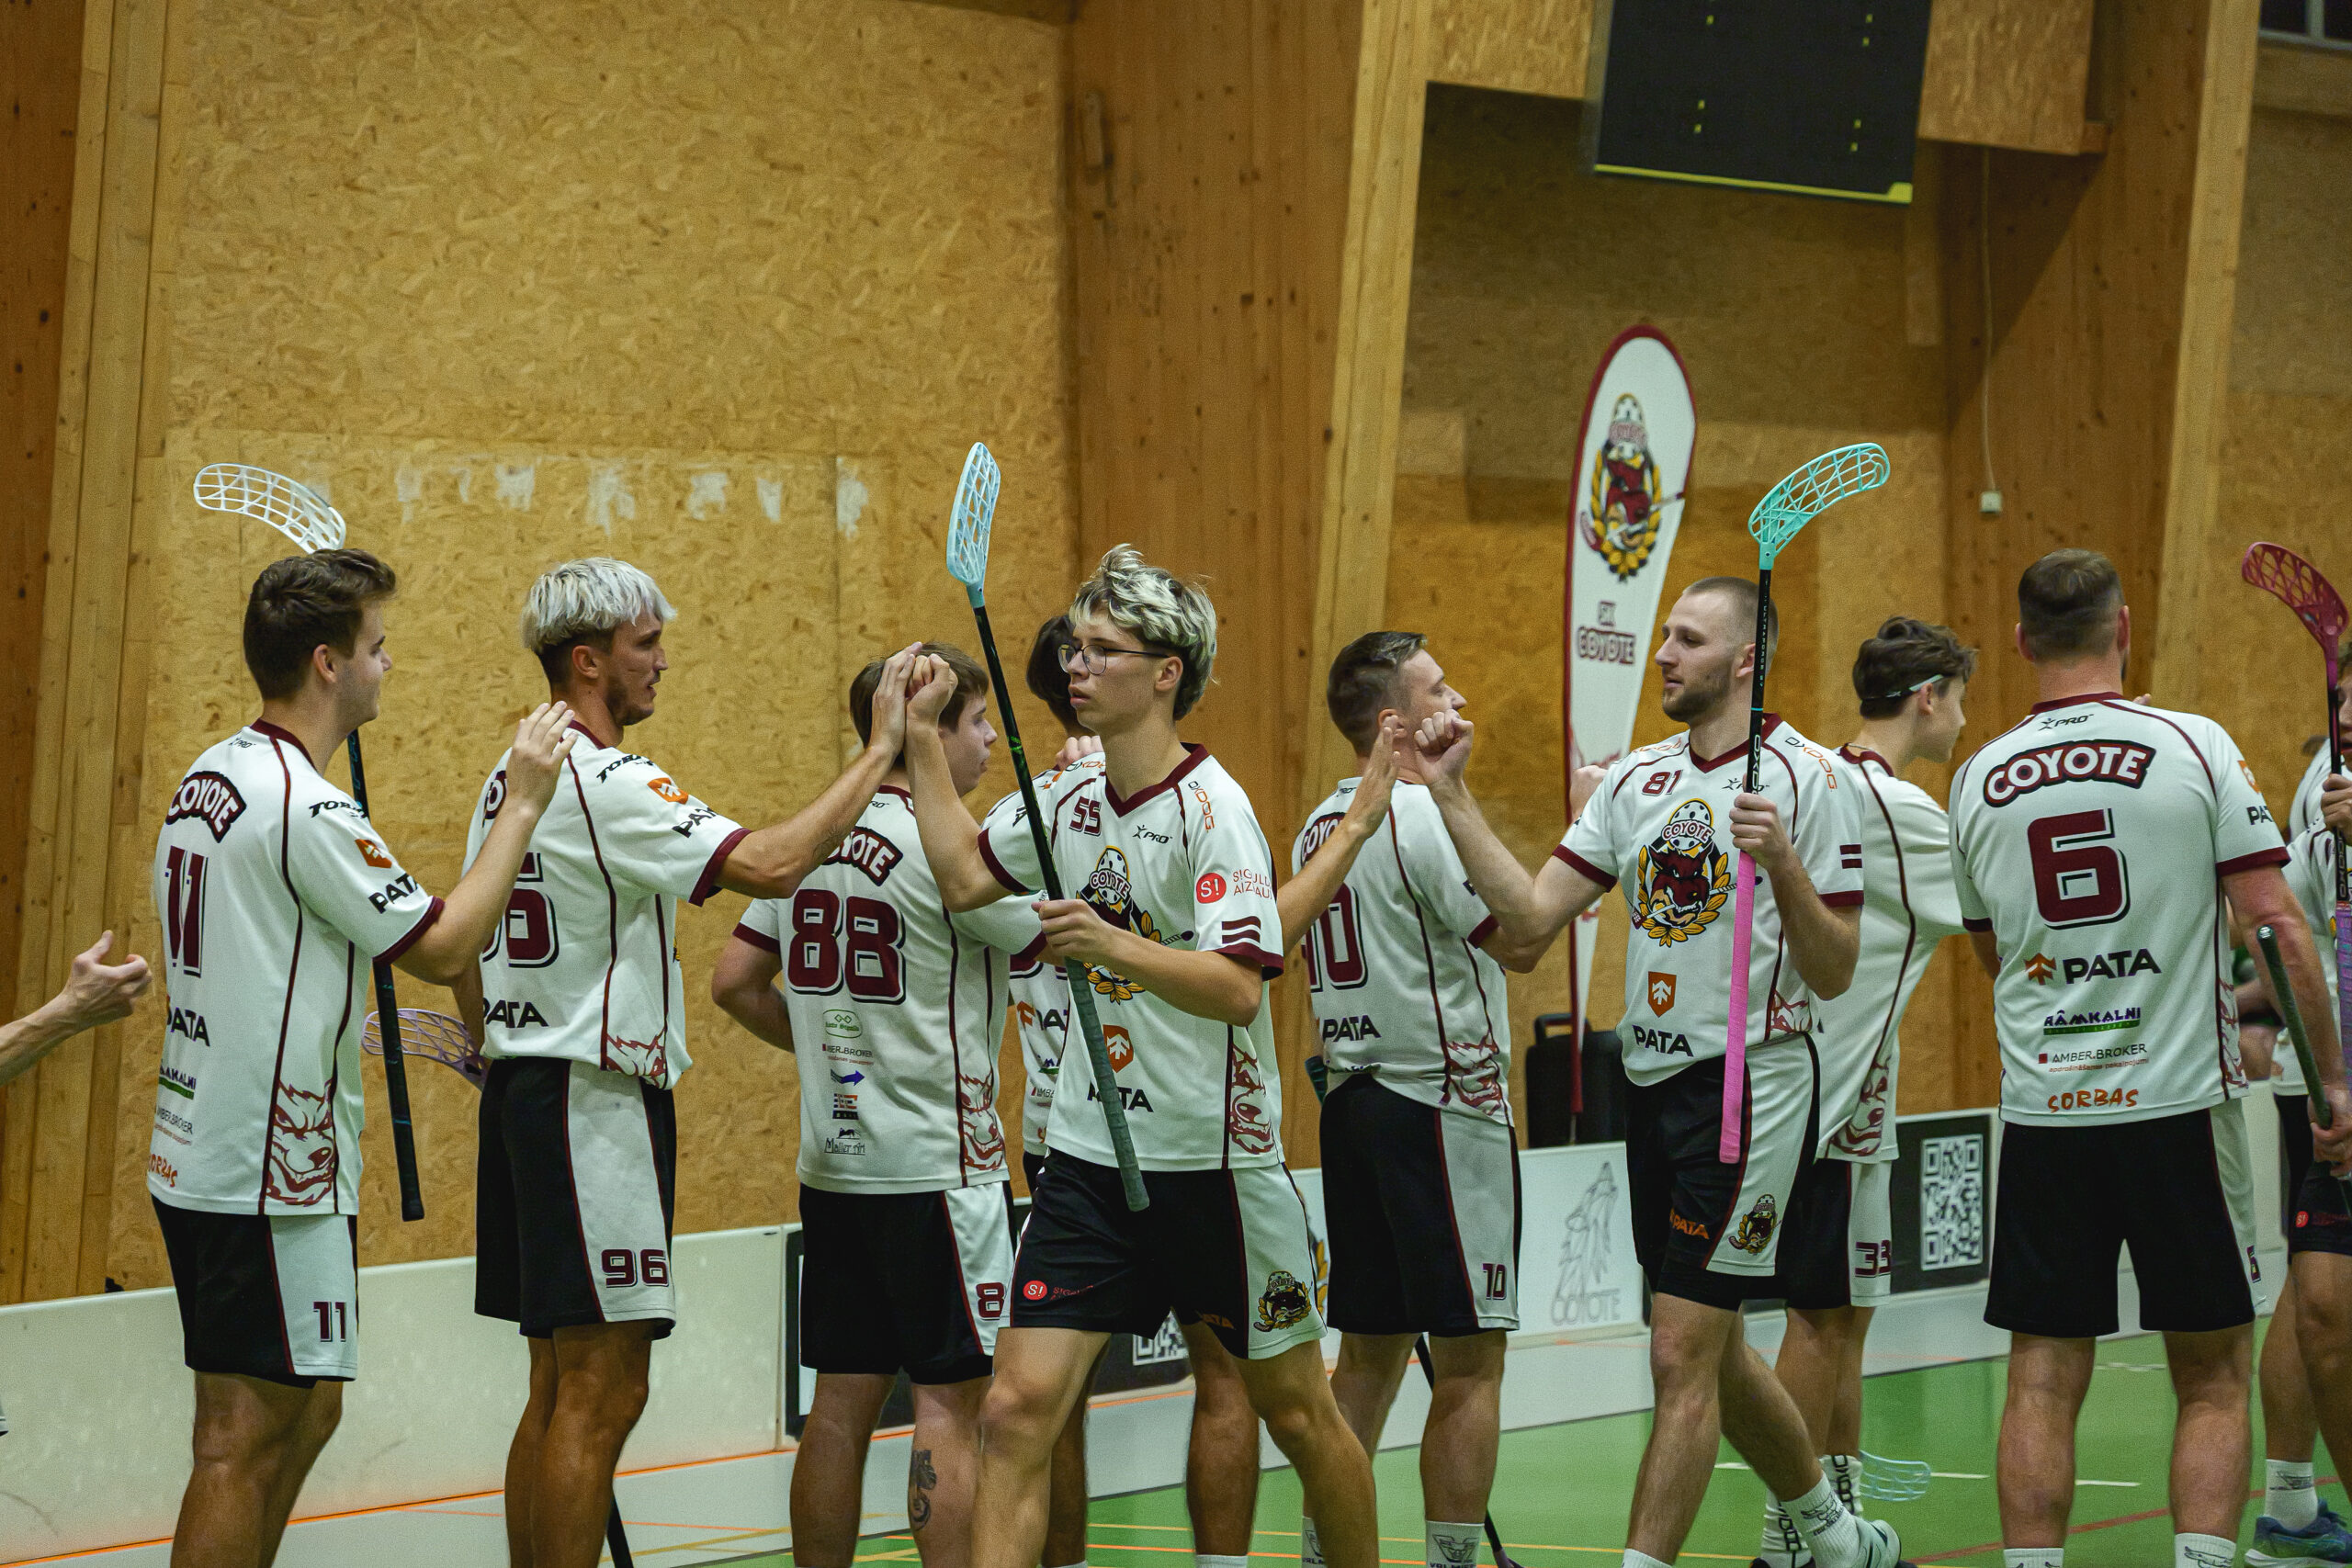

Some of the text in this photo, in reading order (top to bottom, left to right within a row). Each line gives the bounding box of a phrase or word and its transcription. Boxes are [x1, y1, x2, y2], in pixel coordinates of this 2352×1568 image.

[1577, 626, 1635, 664] COYOTE
[1641, 769, 1684, 796] 81
[1984, 746, 2150, 803] COYOTE
[168, 778, 240, 835] COYOTE
[1069, 795, 1102, 838] 55
[1663, 819, 1714, 843] COYOTE
[1090, 868, 1131, 901] COYOTE
[2027, 807, 2131, 931] 6
[1200, 878, 1220, 898] S!
[165, 844, 209, 978] 11
[787, 888, 907, 1005] 88
[2063, 948, 2162, 985] PATA
[1322, 1014, 1382, 1043] PATA
[1632, 1024, 1694, 1058] PATA
[2052, 1043, 2147, 1064] AMBER.BROKER
[2047, 1088, 2140, 1114] SORBAS
[601, 1248, 670, 1289] 96
[1482, 1263, 1507, 1302] 10
[1028, 1284, 1044, 1297] S!
[312, 1301, 347, 1343] 11
